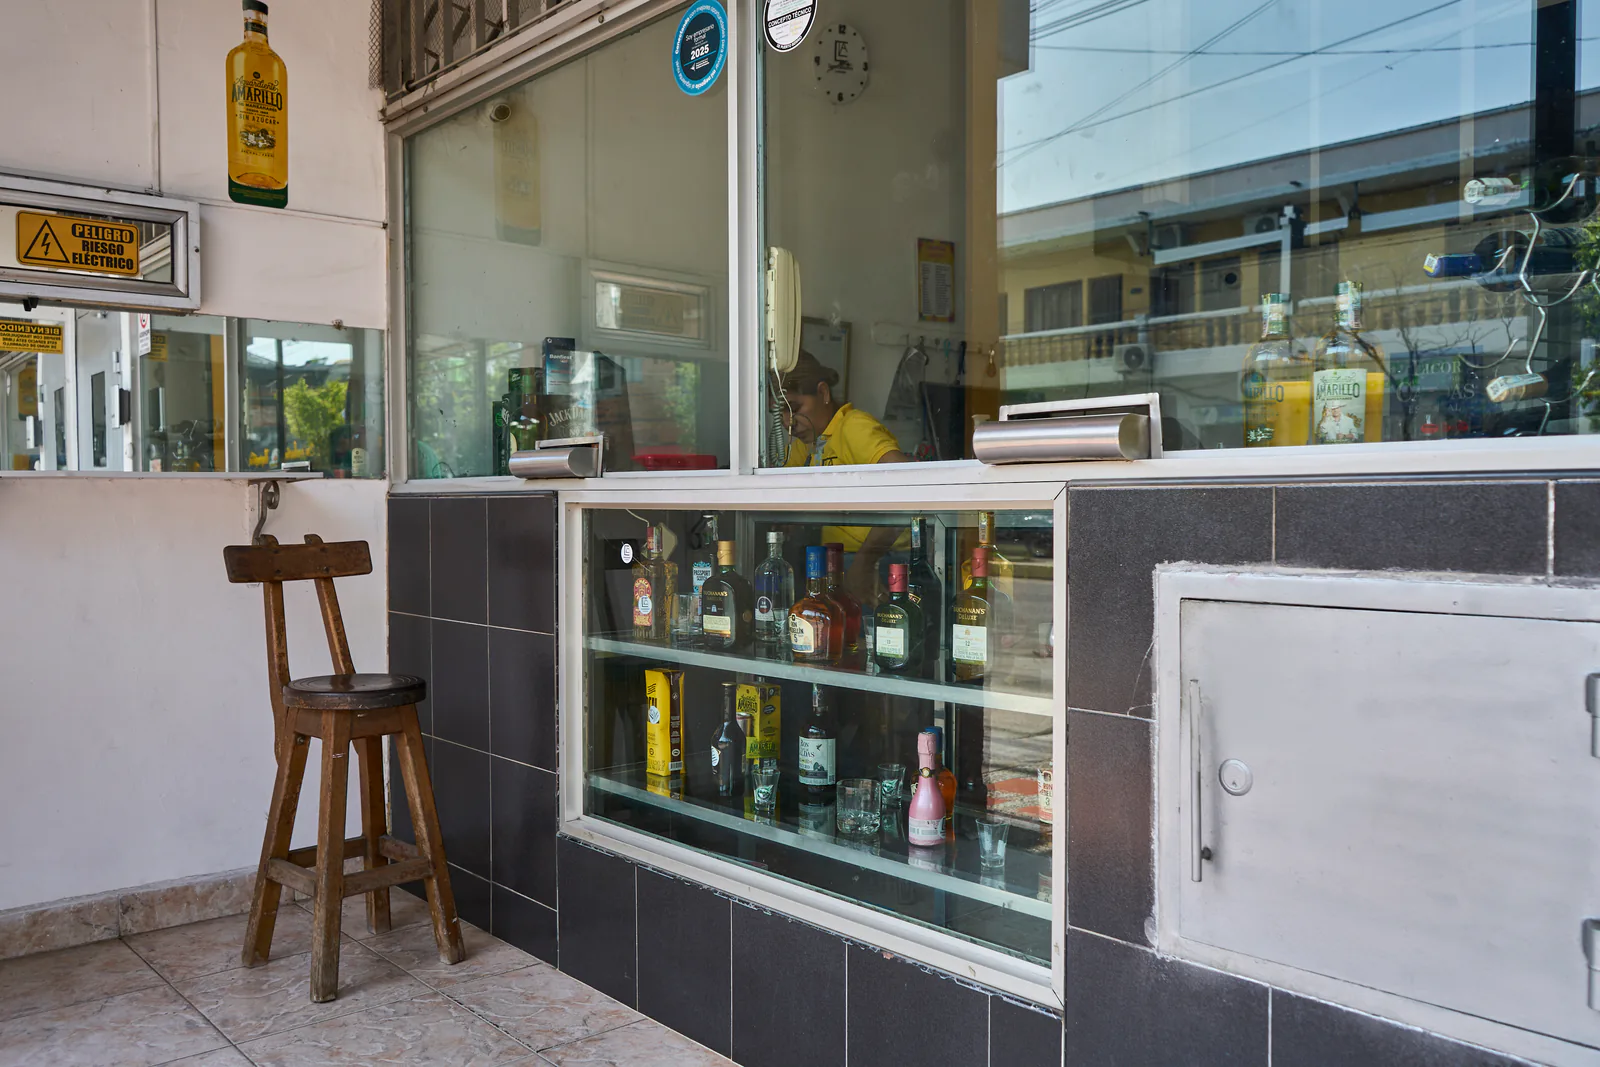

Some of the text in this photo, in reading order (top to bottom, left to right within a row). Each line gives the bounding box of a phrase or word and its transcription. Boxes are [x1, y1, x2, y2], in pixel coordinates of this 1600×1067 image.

[768, 14, 792, 27] CONCEPTO
[690, 43, 710, 60] 2025
[231, 82, 283, 111] AMARILLO
[239, 113, 249, 121] SIN
[75, 224, 131, 243] PELIGRO
[81, 240, 125, 256] RIESGO
[72, 252, 134, 270] ELÉCTRICO
[1315, 382, 1361, 400] AMARILLO
[549, 407, 572, 427] JACK
